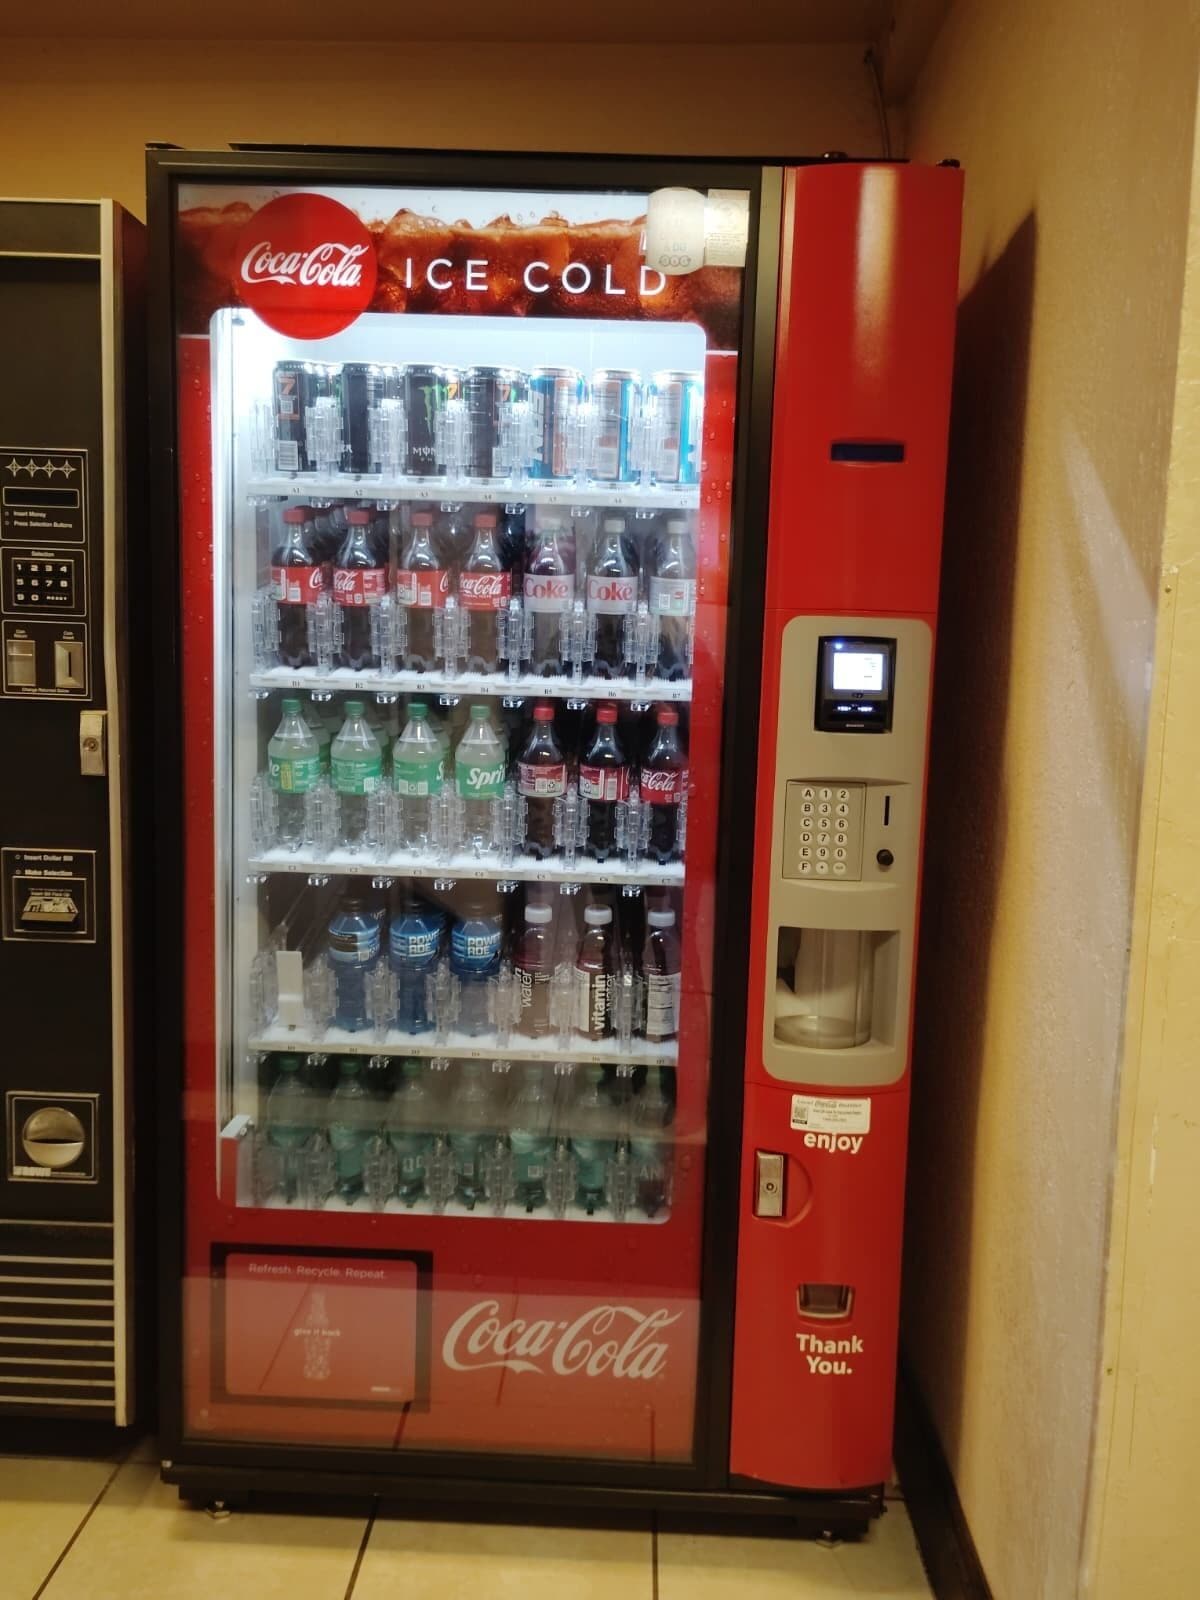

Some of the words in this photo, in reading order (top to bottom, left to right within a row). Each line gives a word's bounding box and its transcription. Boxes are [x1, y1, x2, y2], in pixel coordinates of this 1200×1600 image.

[241, 240, 369, 287] Coca-Cola
[406, 257, 489, 291] ICE
[524, 262, 667, 296] COLD
[16, 563, 22, 571] 1
[30, 564, 39, 572] 2
[45, 564, 53, 572] 3
[59, 565, 67, 573] 4
[524, 576, 569, 599] Coke
[588, 579, 633, 601] Coke
[804, 789, 812, 797] A
[823, 790, 828, 798] 1
[840, 790, 846, 798] 2
[804, 804, 811, 812] B
[822, 804, 828, 812] 3
[839, 805, 845, 813] 4
[803, 818, 810, 827] C
[821, 819, 828, 828] 5
[838, 820, 845, 828] 6
[802, 833, 810, 841] D
[821, 834, 826, 842] 7
[802, 848, 808, 856] E
[820, 848, 826, 857] 9
[837, 849, 843, 857] 0
[801, 862, 808, 870] F
[522, 969, 532, 1008] water
[591, 974, 606, 1031] vitamin
[804, 1132, 863, 1154] enjoy
[442, 1300, 683, 1380] Coca-Cola
[796, 1333, 864, 1353] Thank
[806, 1355, 853, 1375] You.
